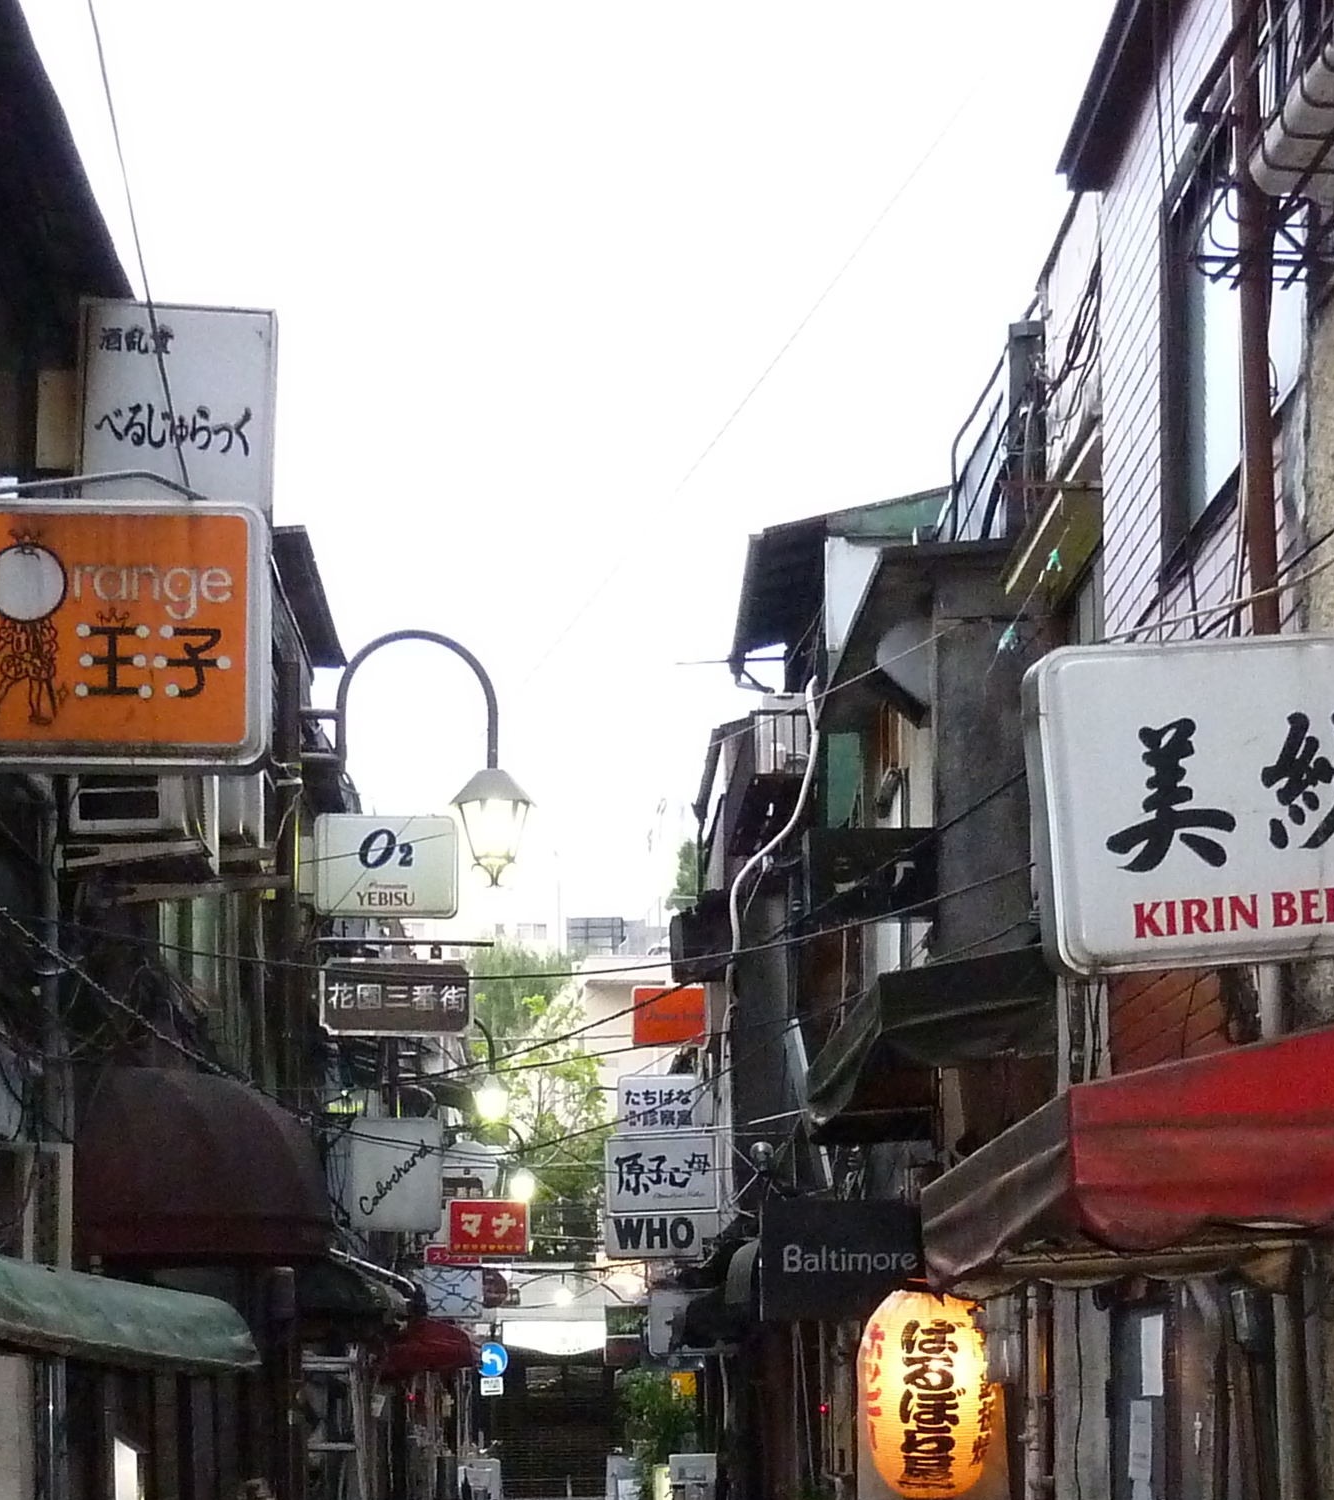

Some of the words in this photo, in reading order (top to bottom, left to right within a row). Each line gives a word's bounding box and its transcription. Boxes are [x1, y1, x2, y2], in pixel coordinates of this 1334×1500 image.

[94, 403, 252, 457] べるじゅらっく
[74, 624, 232, 698] 王子
[356, 891, 416, 907] YEBISU
[1133, 893, 1259, 939] KIRIN
[327, 983, 467, 1012] 花園三番街
[624, 1089, 692, 1106] たちばな
[614, 1152, 711, 1196] 原子心母
[613, 1217, 695, 1251] WHO
[782, 1243, 918, 1274] Baltimore
[899, 1318, 966, 1489] ばるぼら屋
